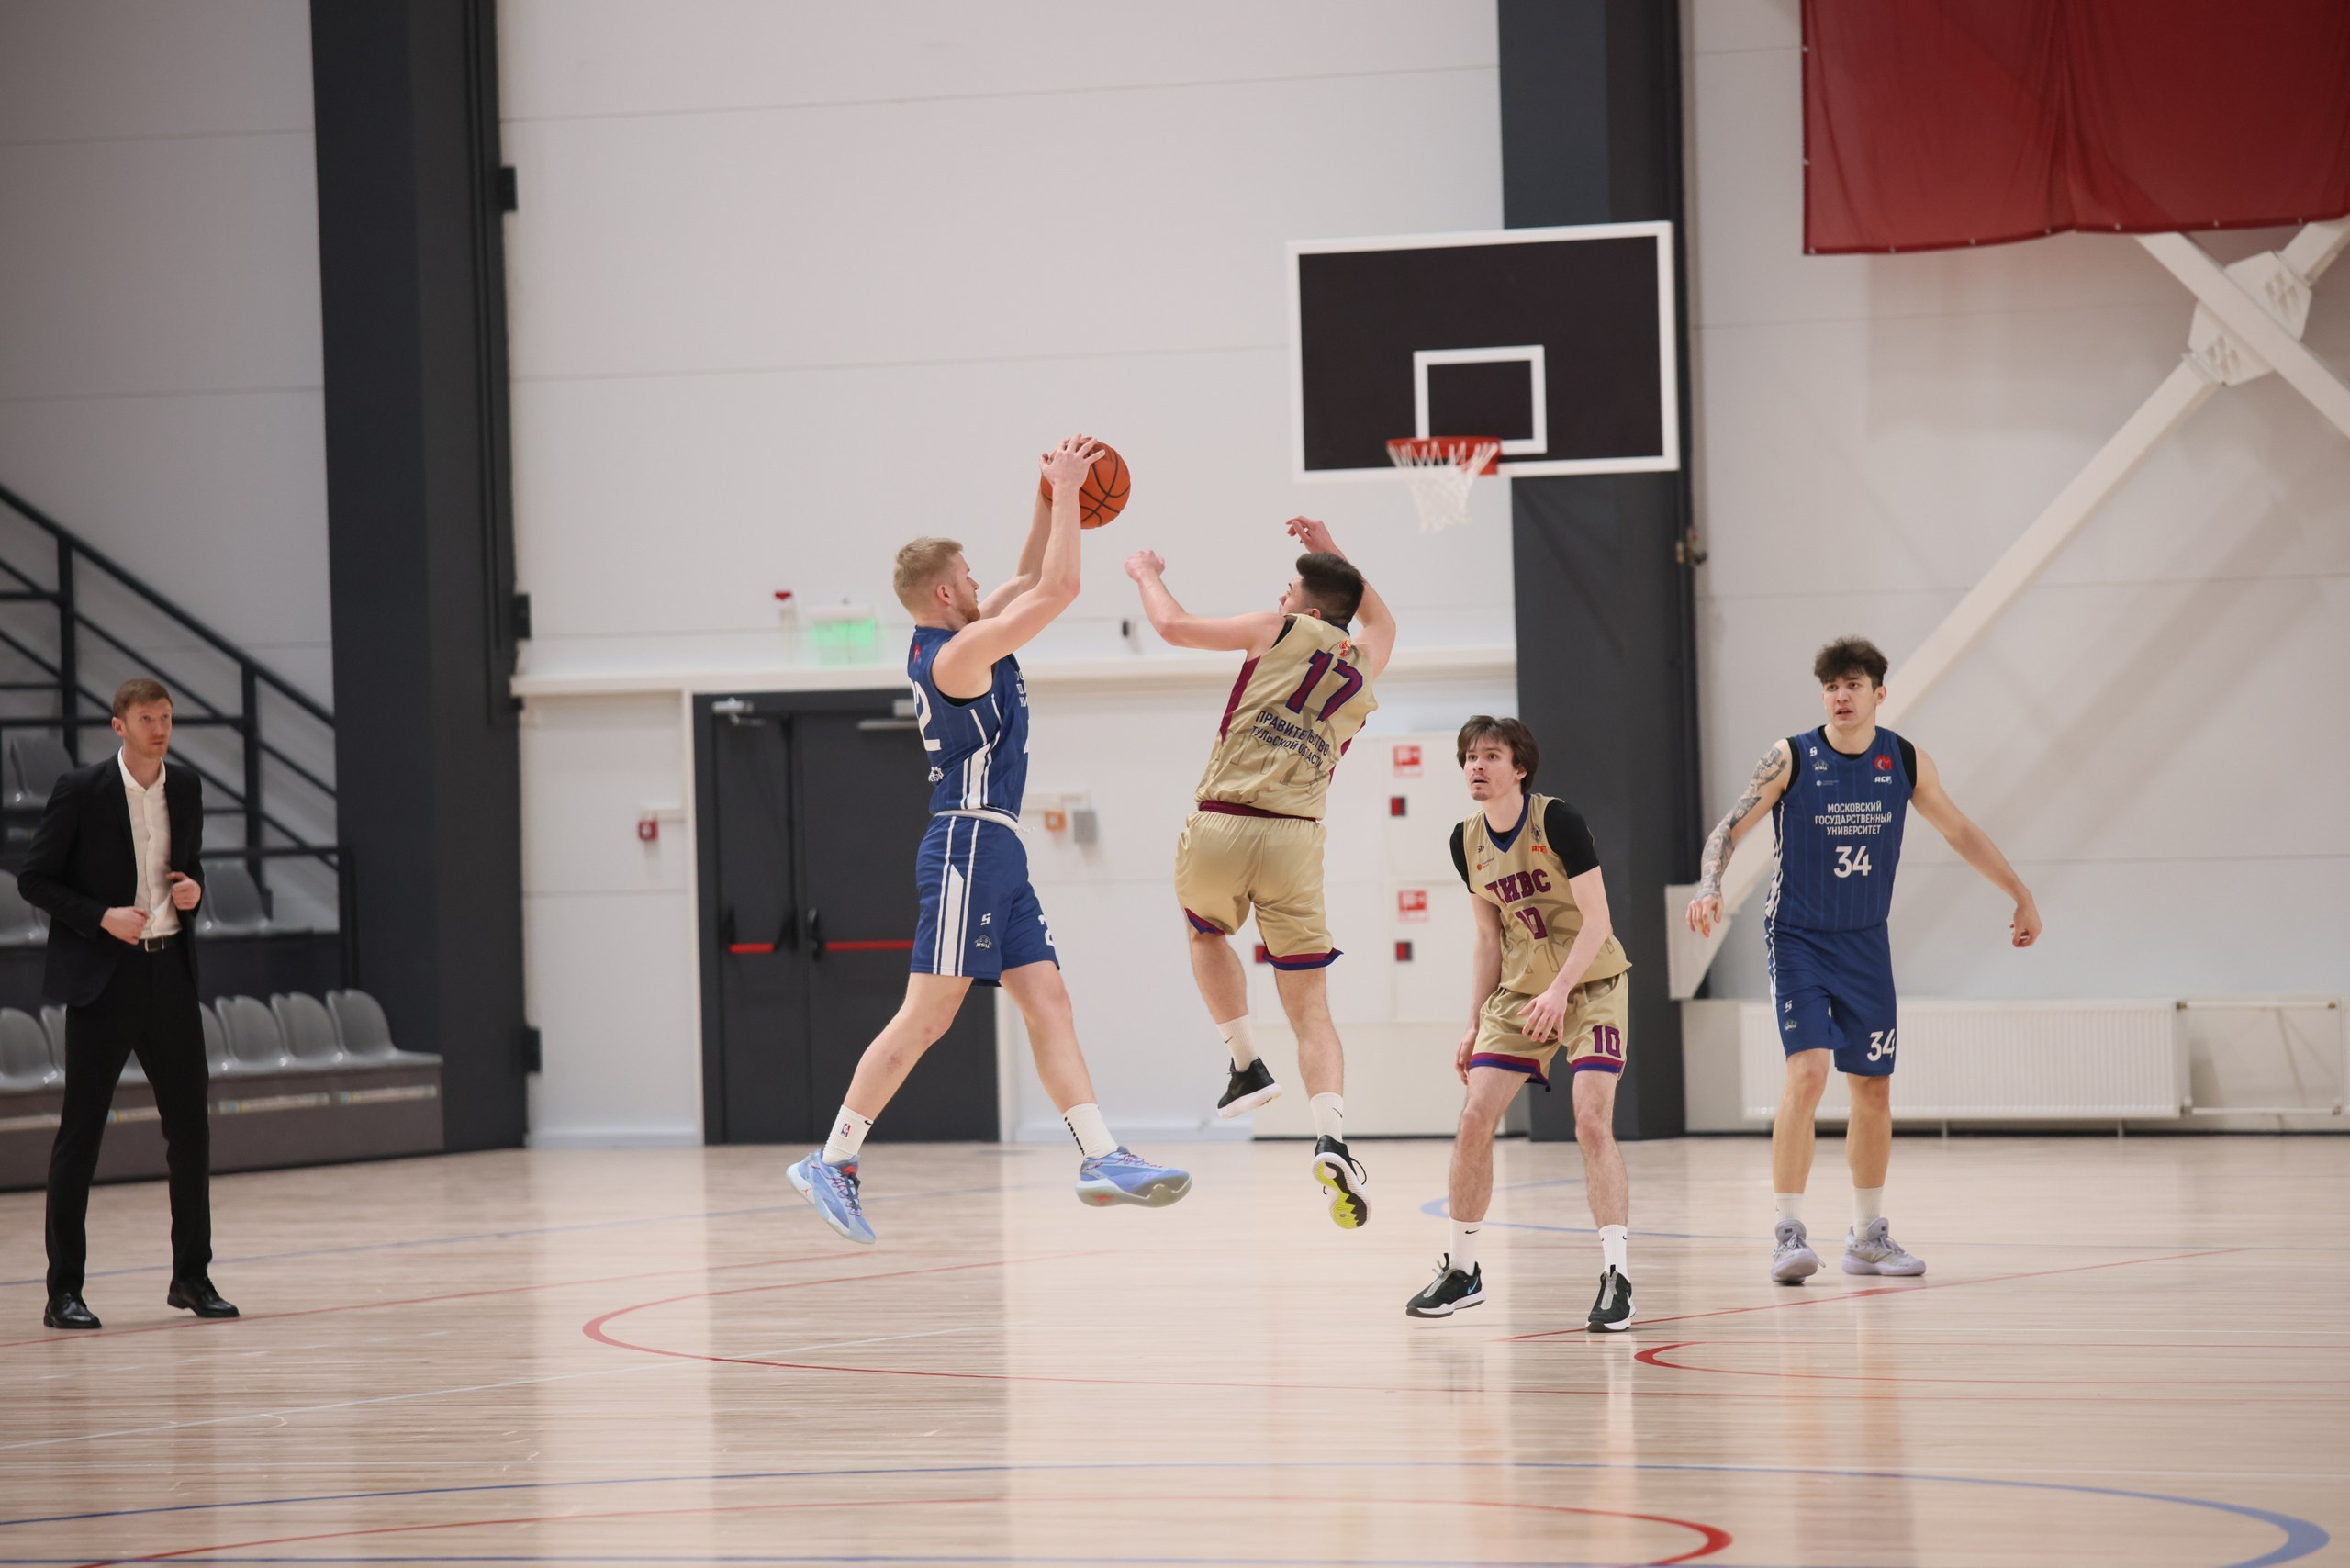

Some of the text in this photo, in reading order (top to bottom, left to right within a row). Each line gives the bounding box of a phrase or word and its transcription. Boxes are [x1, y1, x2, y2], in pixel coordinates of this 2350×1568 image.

[1285, 649, 1363, 722] 17
[909, 676, 942, 752] 2
[1249, 725, 1324, 770] ТУЛЬСКОЙ ОБАСТИ
[1815, 812, 1892, 825] ГОСУДАРСТВЕННЫЙ
[1827, 801, 1882, 813] МОСКОВСКИЙ
[1826, 824, 1882, 836] УНИВЕРСИТЕТ
[1833, 845, 1872, 879] 34
[1592, 1025, 1622, 1058] 10
[1866, 1027, 1896, 1062] 34
